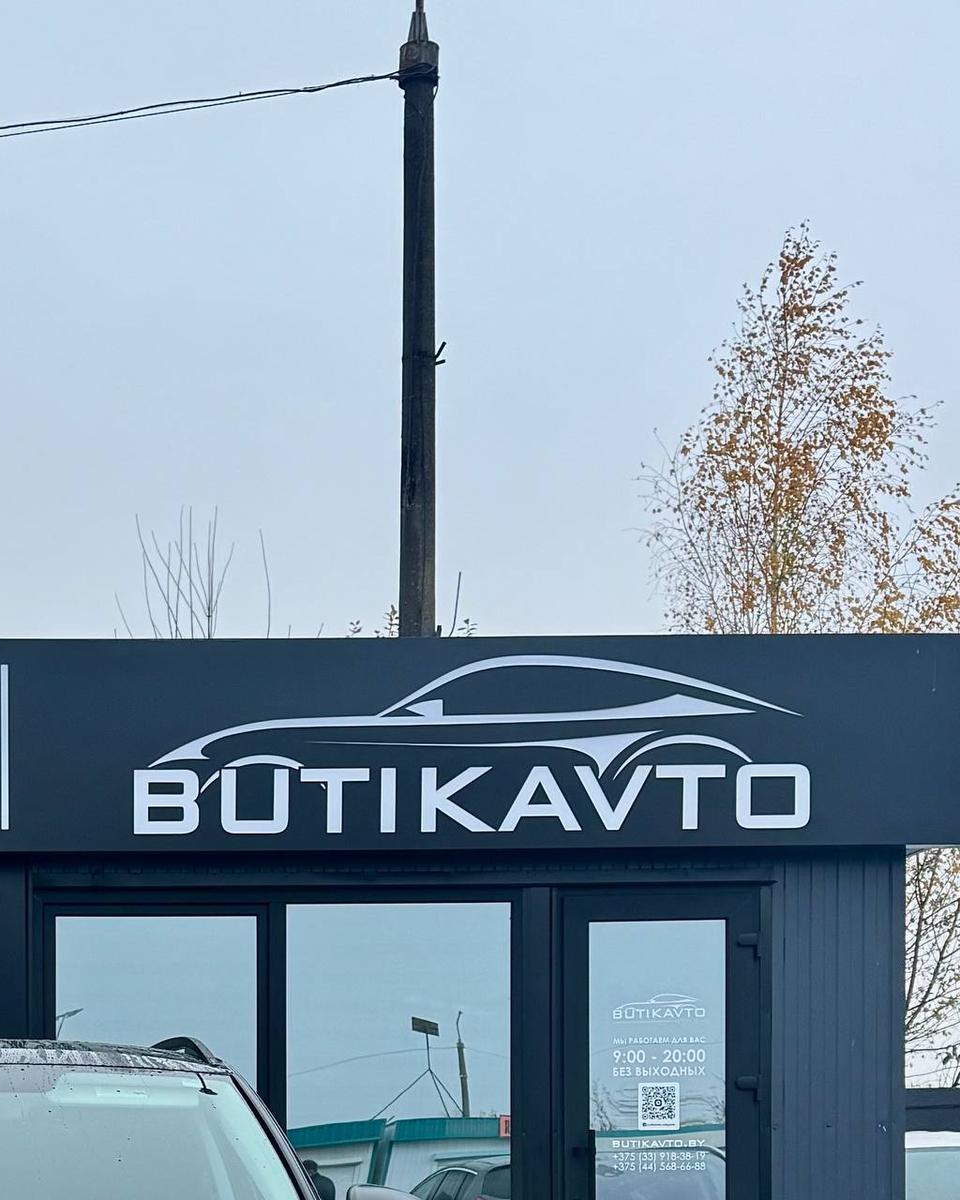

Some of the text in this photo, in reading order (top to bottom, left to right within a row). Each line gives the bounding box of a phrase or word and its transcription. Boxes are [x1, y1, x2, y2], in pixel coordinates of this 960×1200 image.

[133, 762, 812, 836] BUTIKAVTO
[612, 1007, 706, 1020] BUTIKAVTO
[613, 1049, 646, 1064] 9:00
[662, 1048, 706, 1063] 20:00
[612, 1066, 706, 1077] БЕЗ ВЫХОДНЫХ
[612, 1139, 706, 1148] BUTIKAVTO.BY
[613, 1152, 636, 1161] +375
[638, 1152, 656, 1163] (33)
[613, 1162, 636, 1171] +375
[638, 1162, 656, 1172] (44)
